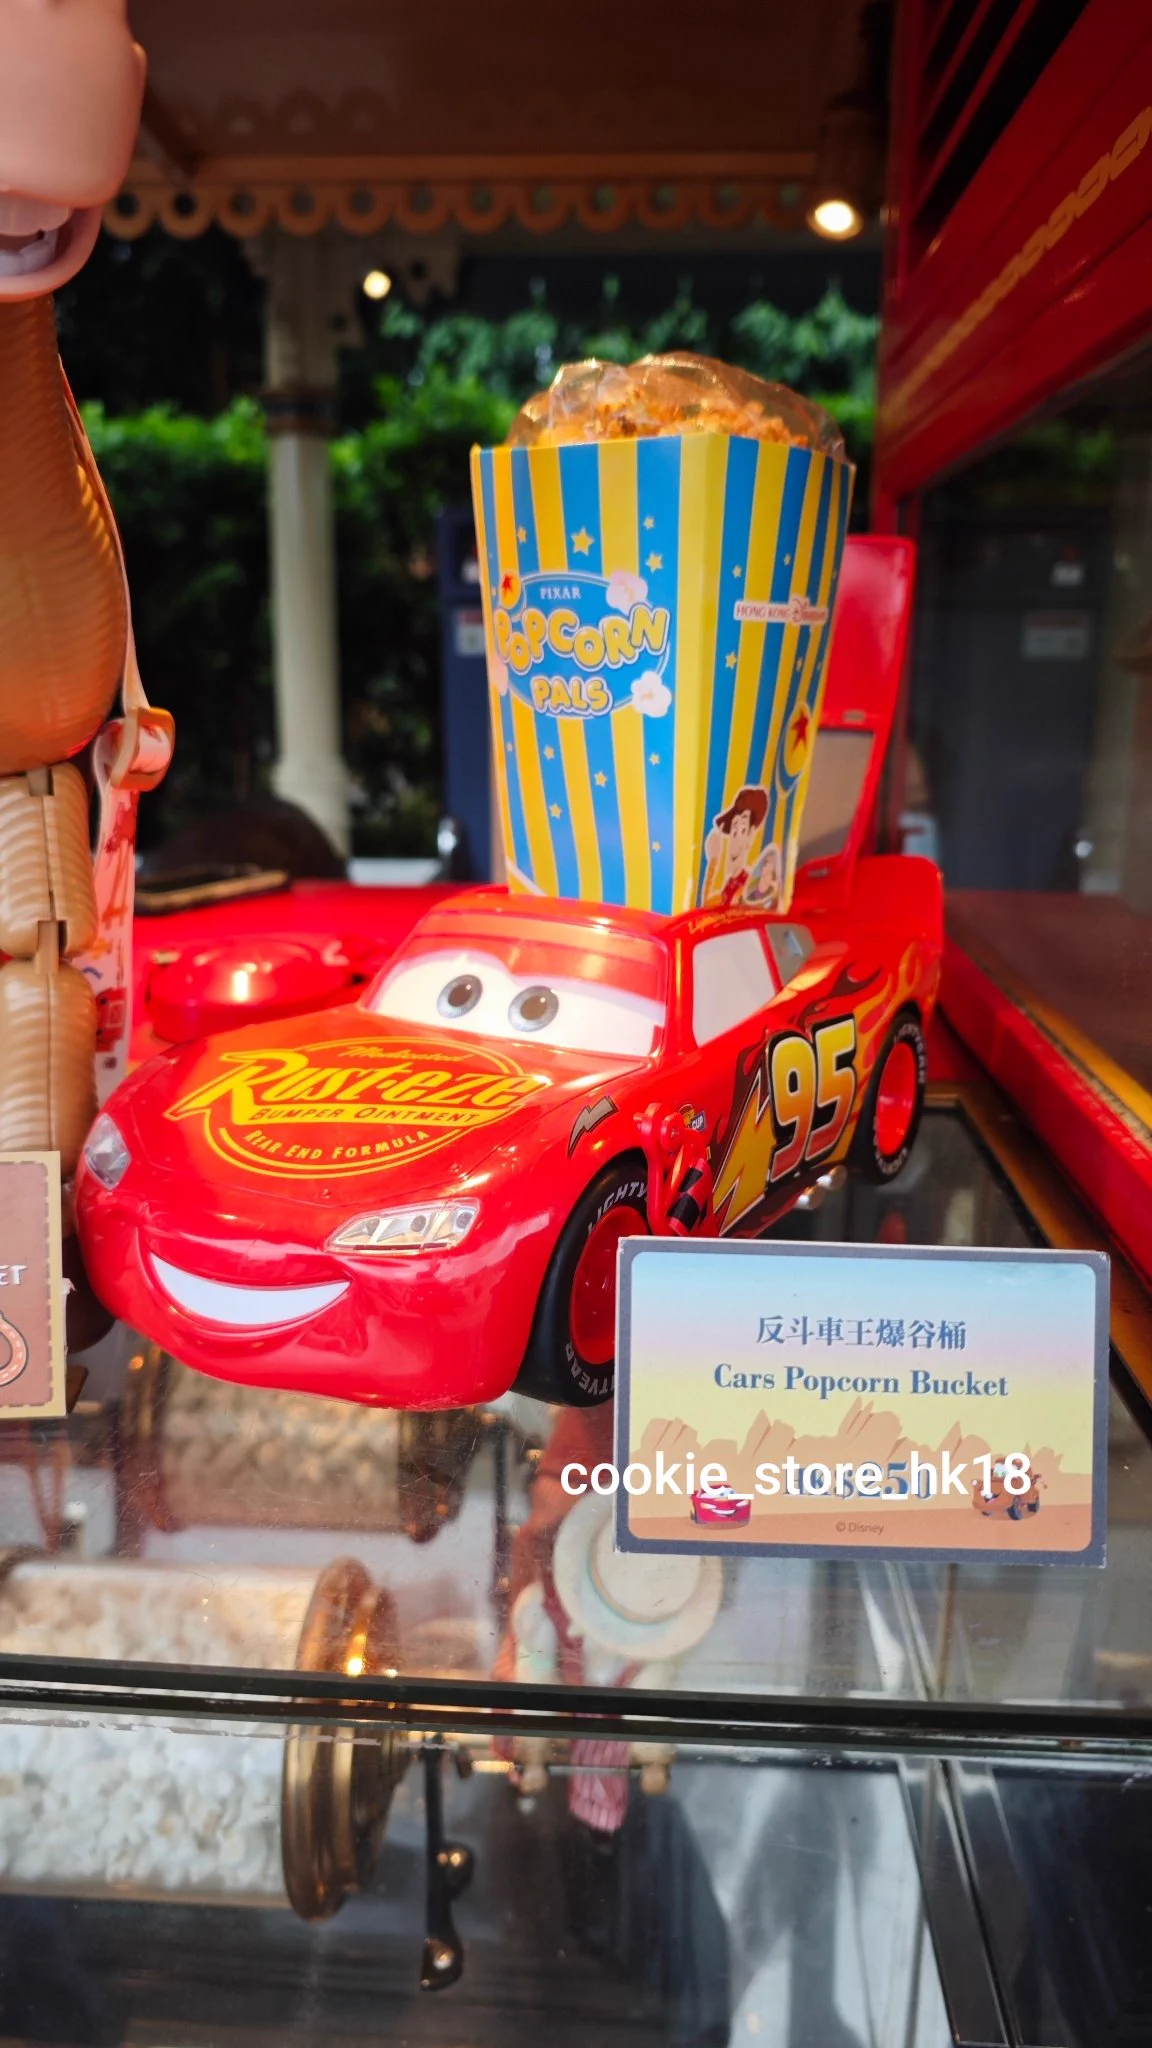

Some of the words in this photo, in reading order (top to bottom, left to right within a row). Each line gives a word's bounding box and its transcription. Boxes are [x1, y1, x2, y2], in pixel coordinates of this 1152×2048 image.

[540, 587, 581, 600] PIXAR
[736, 604, 766, 619] HONG
[494, 605, 668, 670] POPCORN
[532, 678, 610, 713] PALS
[769, 1013, 857, 1184] 95
[249, 1107, 345, 1121] BUMPER
[354, 1107, 480, 1123] OINTMENT
[691, 1114, 705, 1131] CUP
[243, 1129, 282, 1154] REAR
[285, 1144, 322, 1160] END
[332, 1130, 431, 1160] FORMULA
[756, 1315, 968, 1350] 反斗車王爆谷桶
[714, 1363, 775, 1390] Cars
[784, 1365, 901, 1400] Popcorn
[909, 1369, 1009, 1397] Bucket
[849, 1522, 884, 1535] Disney
